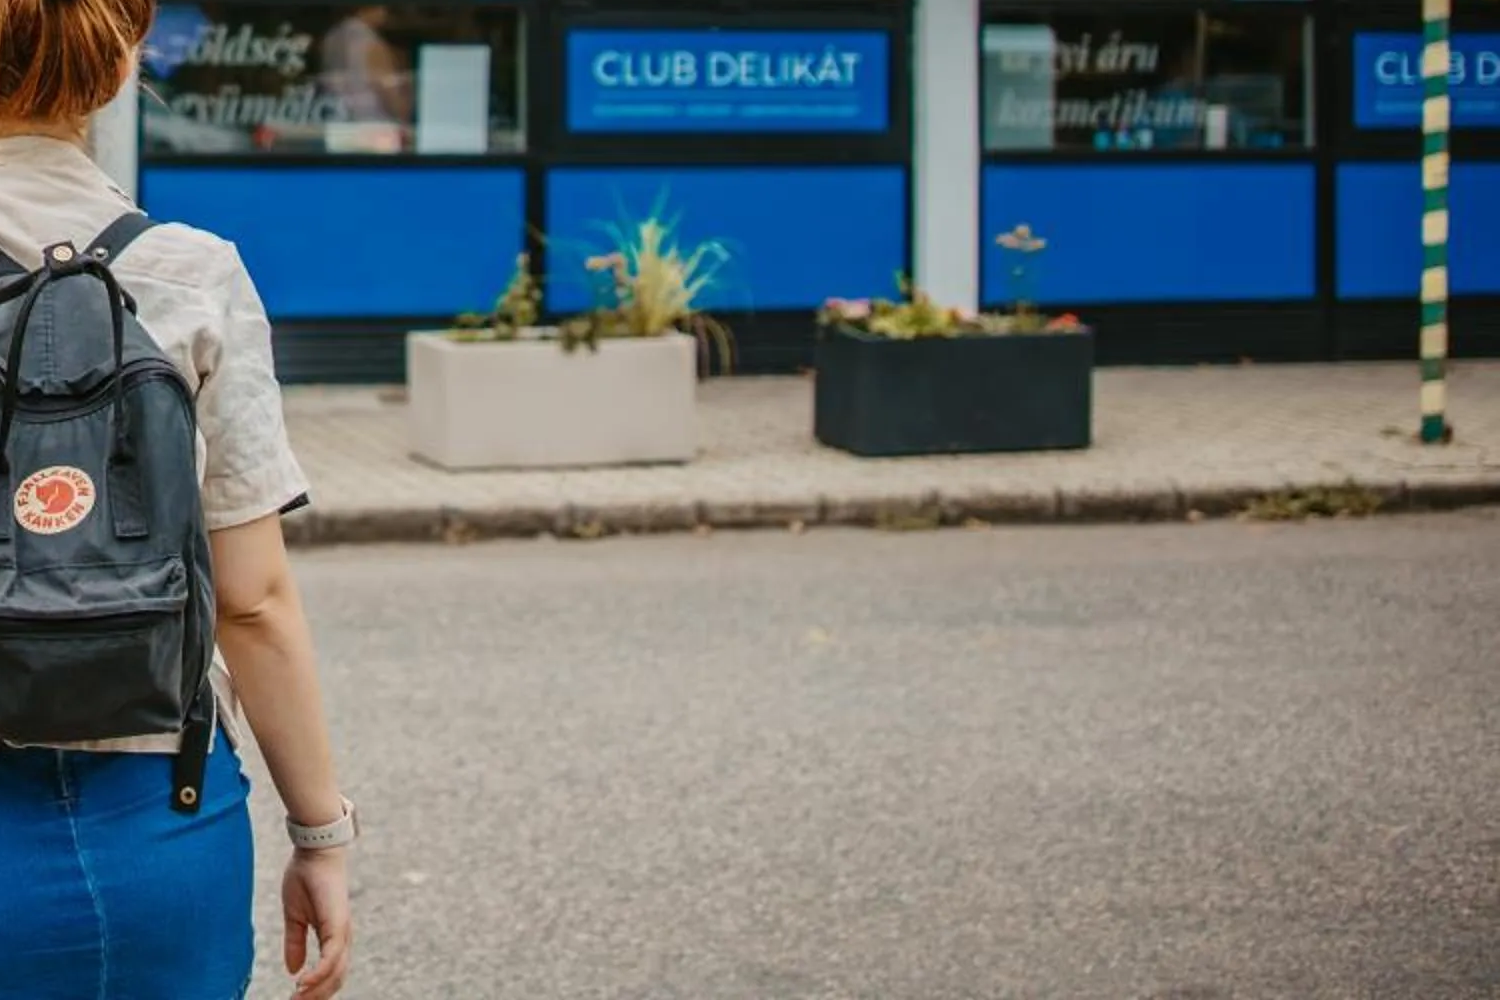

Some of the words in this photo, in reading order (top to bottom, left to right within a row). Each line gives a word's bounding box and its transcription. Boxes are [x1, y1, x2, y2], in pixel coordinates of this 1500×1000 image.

[592, 50, 697, 87] CLUB
[705, 44, 861, 88] DELIKÁT
[1374, 51, 1466, 85] CLB
